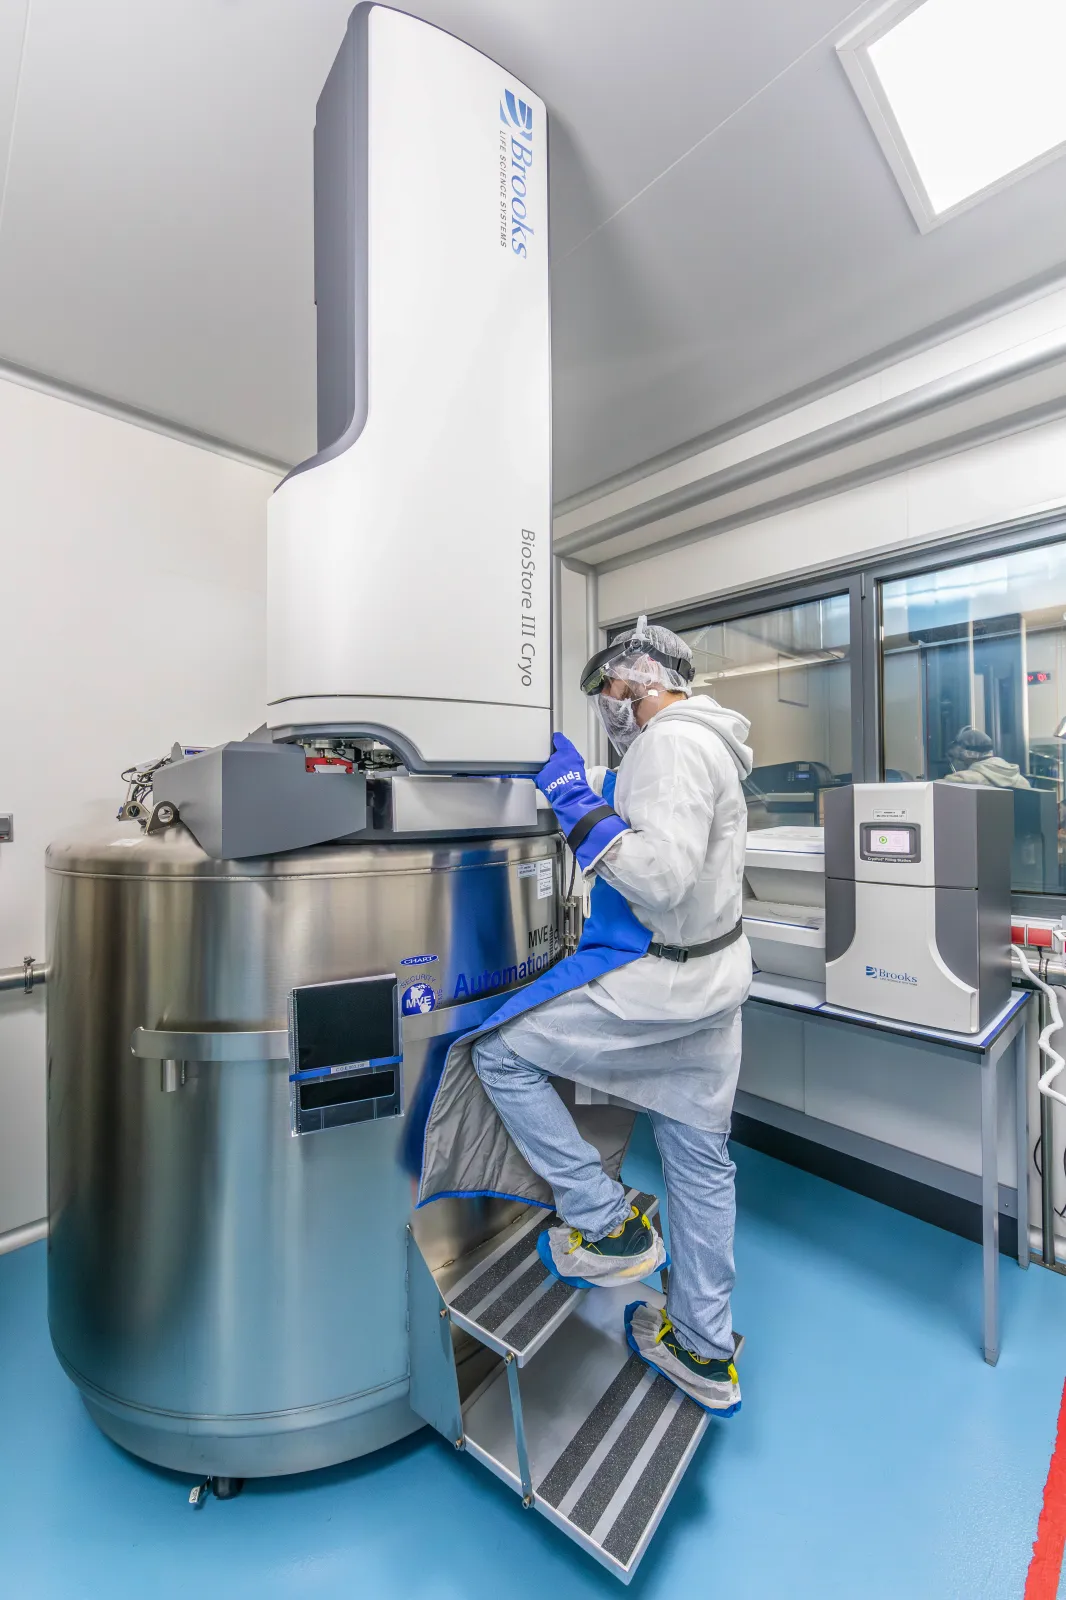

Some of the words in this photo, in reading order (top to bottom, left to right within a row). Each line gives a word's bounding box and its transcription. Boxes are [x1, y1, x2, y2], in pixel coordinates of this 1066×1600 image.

[499, 130, 507, 152] LIFE
[499, 154, 507, 197] SCIENCE
[511, 135, 534, 259] Brooks
[499, 202, 507, 248] SYSTEMS
[521, 529, 535, 608] BioStore
[521, 614, 535, 638] III
[518, 643, 535, 687] Cryo
[545, 770, 581, 794] Epibox
[528, 925, 548, 949] MVE
[403, 956, 433, 965] CHART
[453, 952, 549, 999] Automation
[879, 968, 918, 982] Brooks
[405, 995, 432, 1009] MVE
